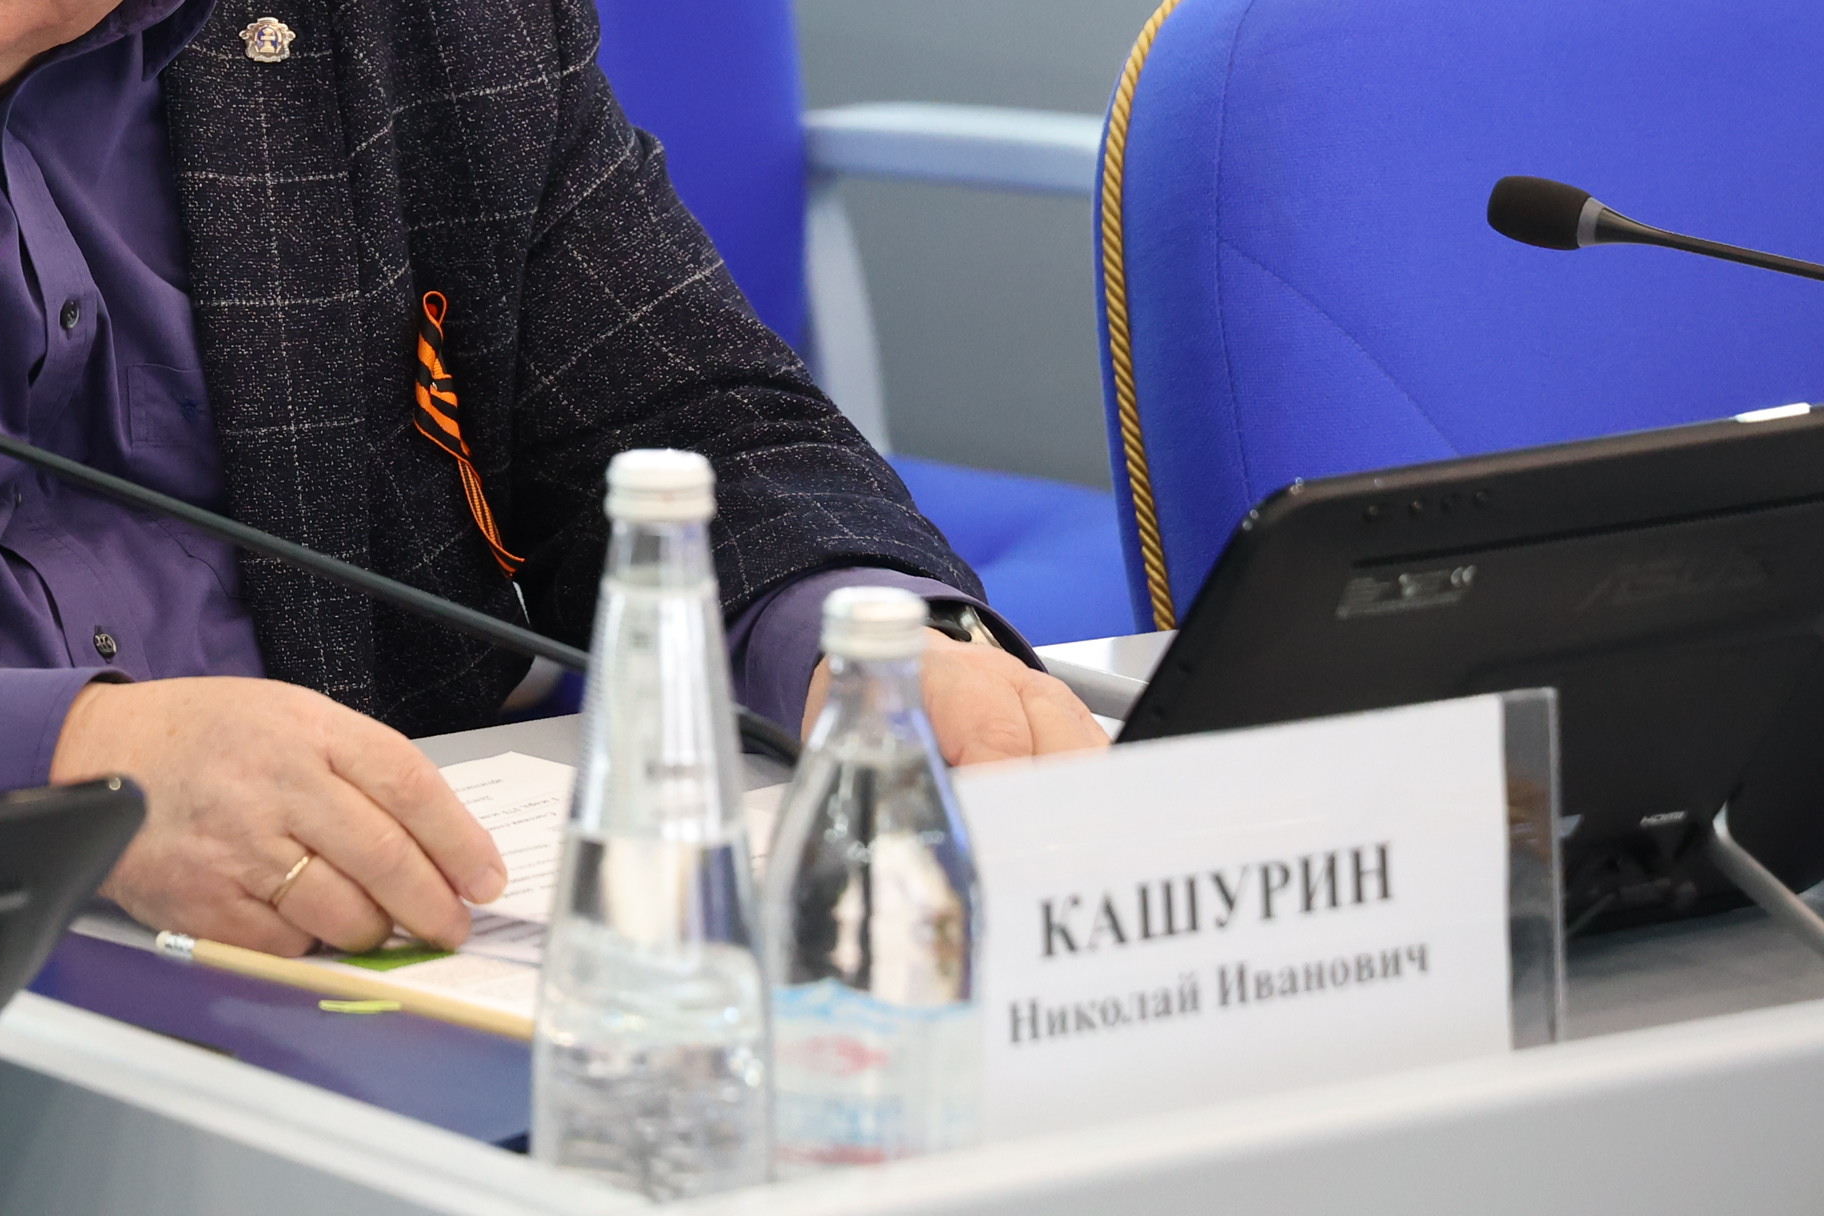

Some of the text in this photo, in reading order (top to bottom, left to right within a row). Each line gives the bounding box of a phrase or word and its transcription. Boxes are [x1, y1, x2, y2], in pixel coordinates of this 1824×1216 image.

[1039, 841, 1394, 960] КАШУРИН
[1008, 943, 1431, 1044] Николай Иванович
